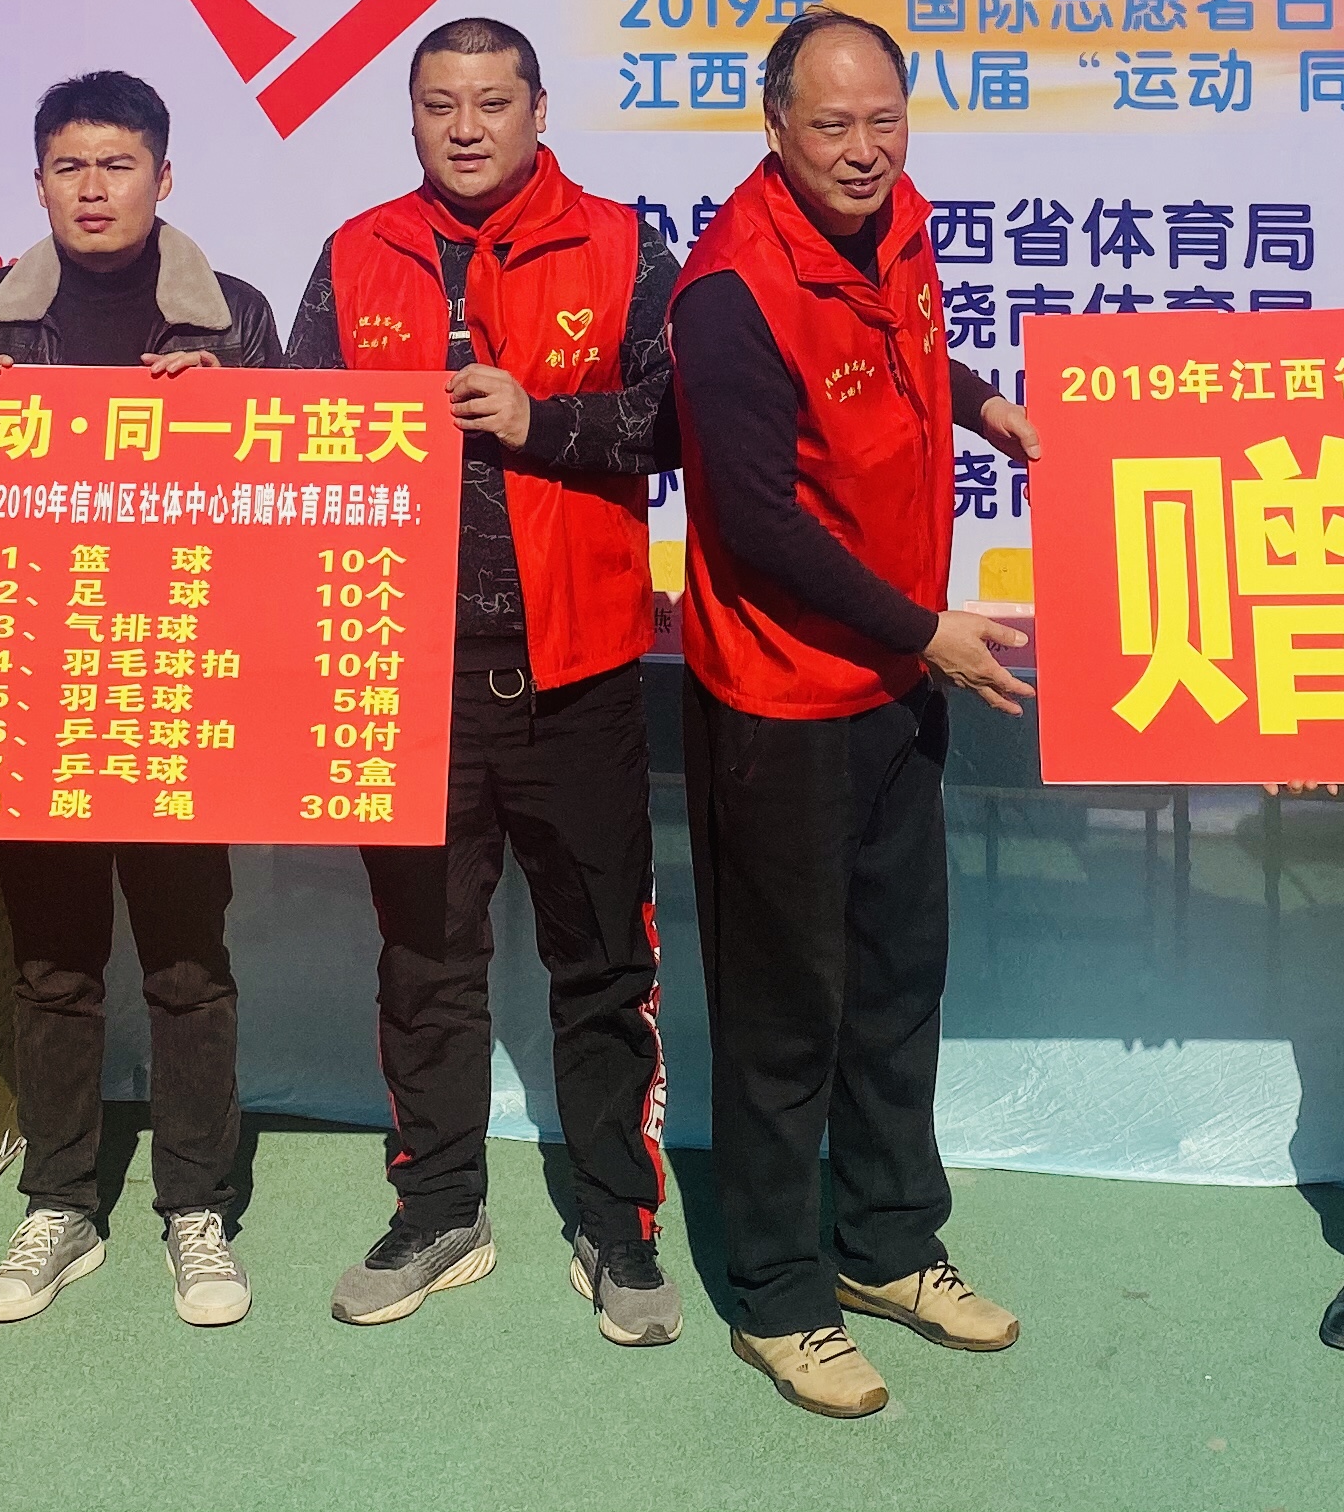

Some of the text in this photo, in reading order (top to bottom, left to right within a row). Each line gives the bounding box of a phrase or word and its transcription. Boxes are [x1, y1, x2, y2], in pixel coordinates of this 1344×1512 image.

[319, 547, 406, 575] 10个
[317, 582, 404, 609] 10个
[317, 616, 405, 644] 10个
[315, 651, 404, 680] 10付
[334, 686, 399, 715] 5桶
[311, 722, 400, 750] 10付
[330, 757, 396, 785] 5盒
[300, 793, 393, 822] 30根
